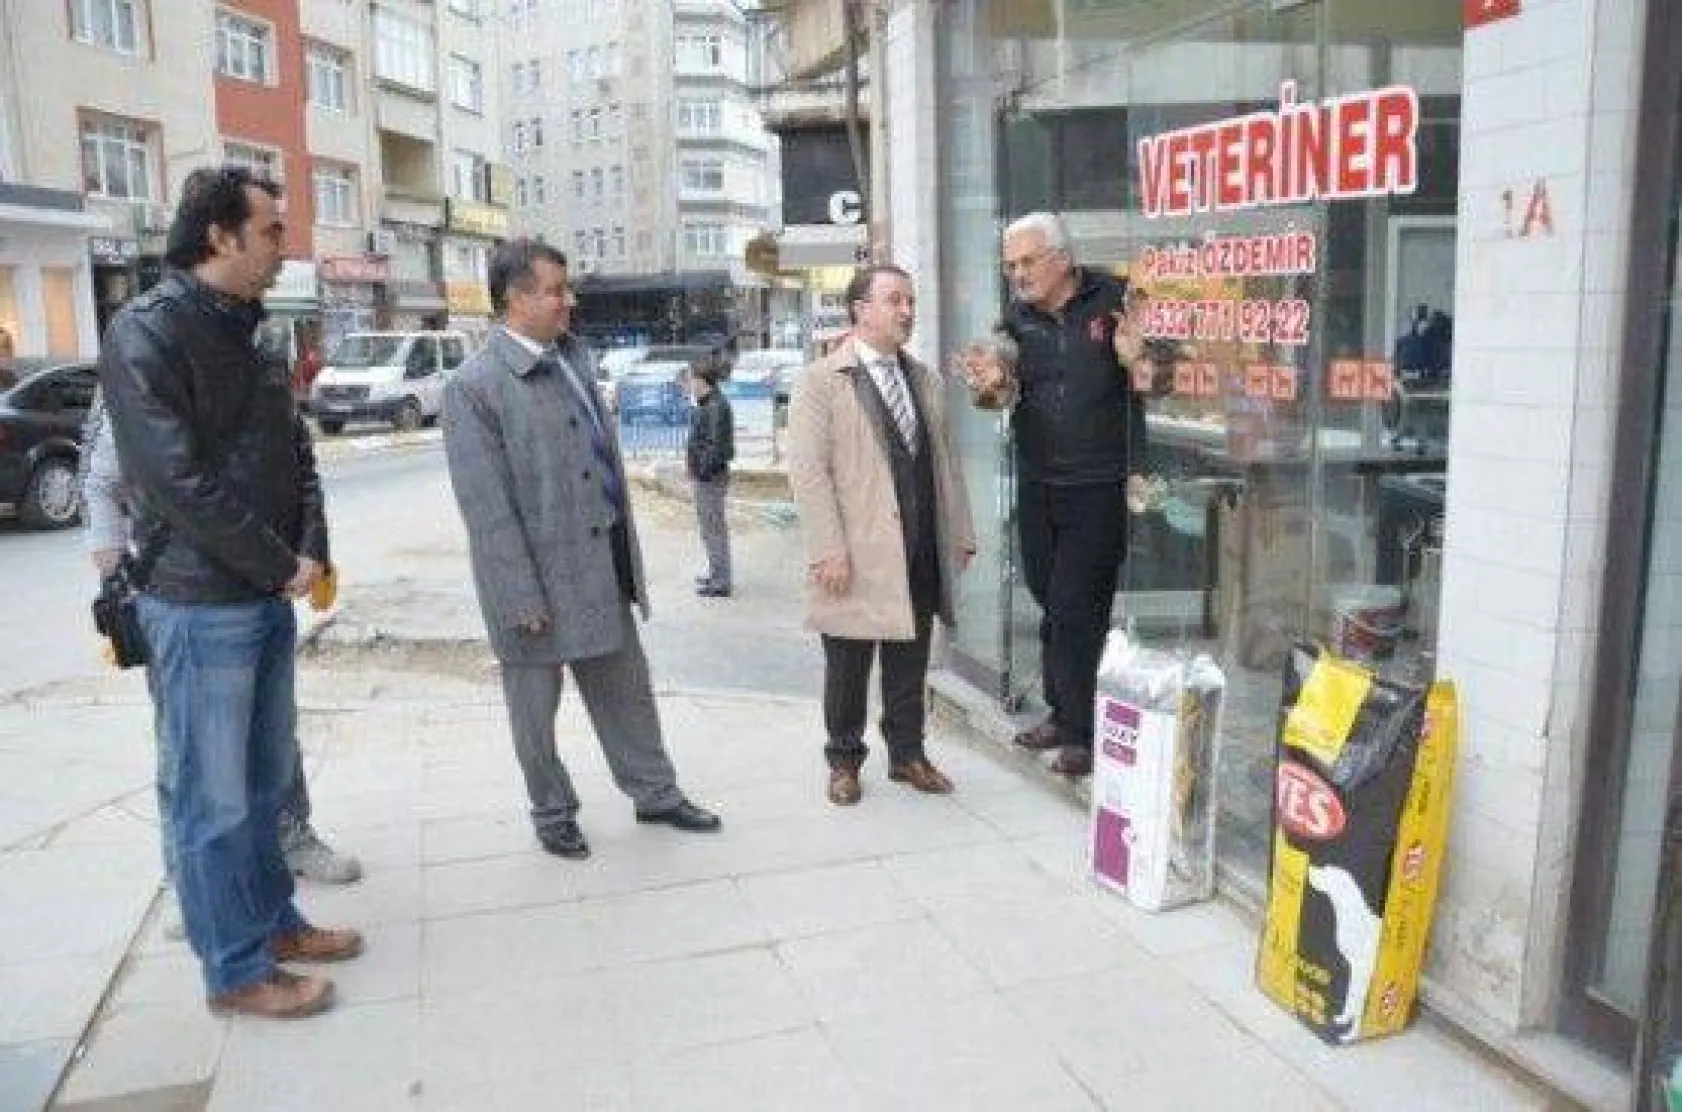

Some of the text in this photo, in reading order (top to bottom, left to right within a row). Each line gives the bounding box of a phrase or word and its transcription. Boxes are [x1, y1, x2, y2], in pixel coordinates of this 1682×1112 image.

[1138, 79, 1418, 218] VETERİNER
[1201, 224, 1316, 277] ÖZDEMİR
[1239, 298, 1270, 343] 92
[1274, 299, 1310, 346] 22
